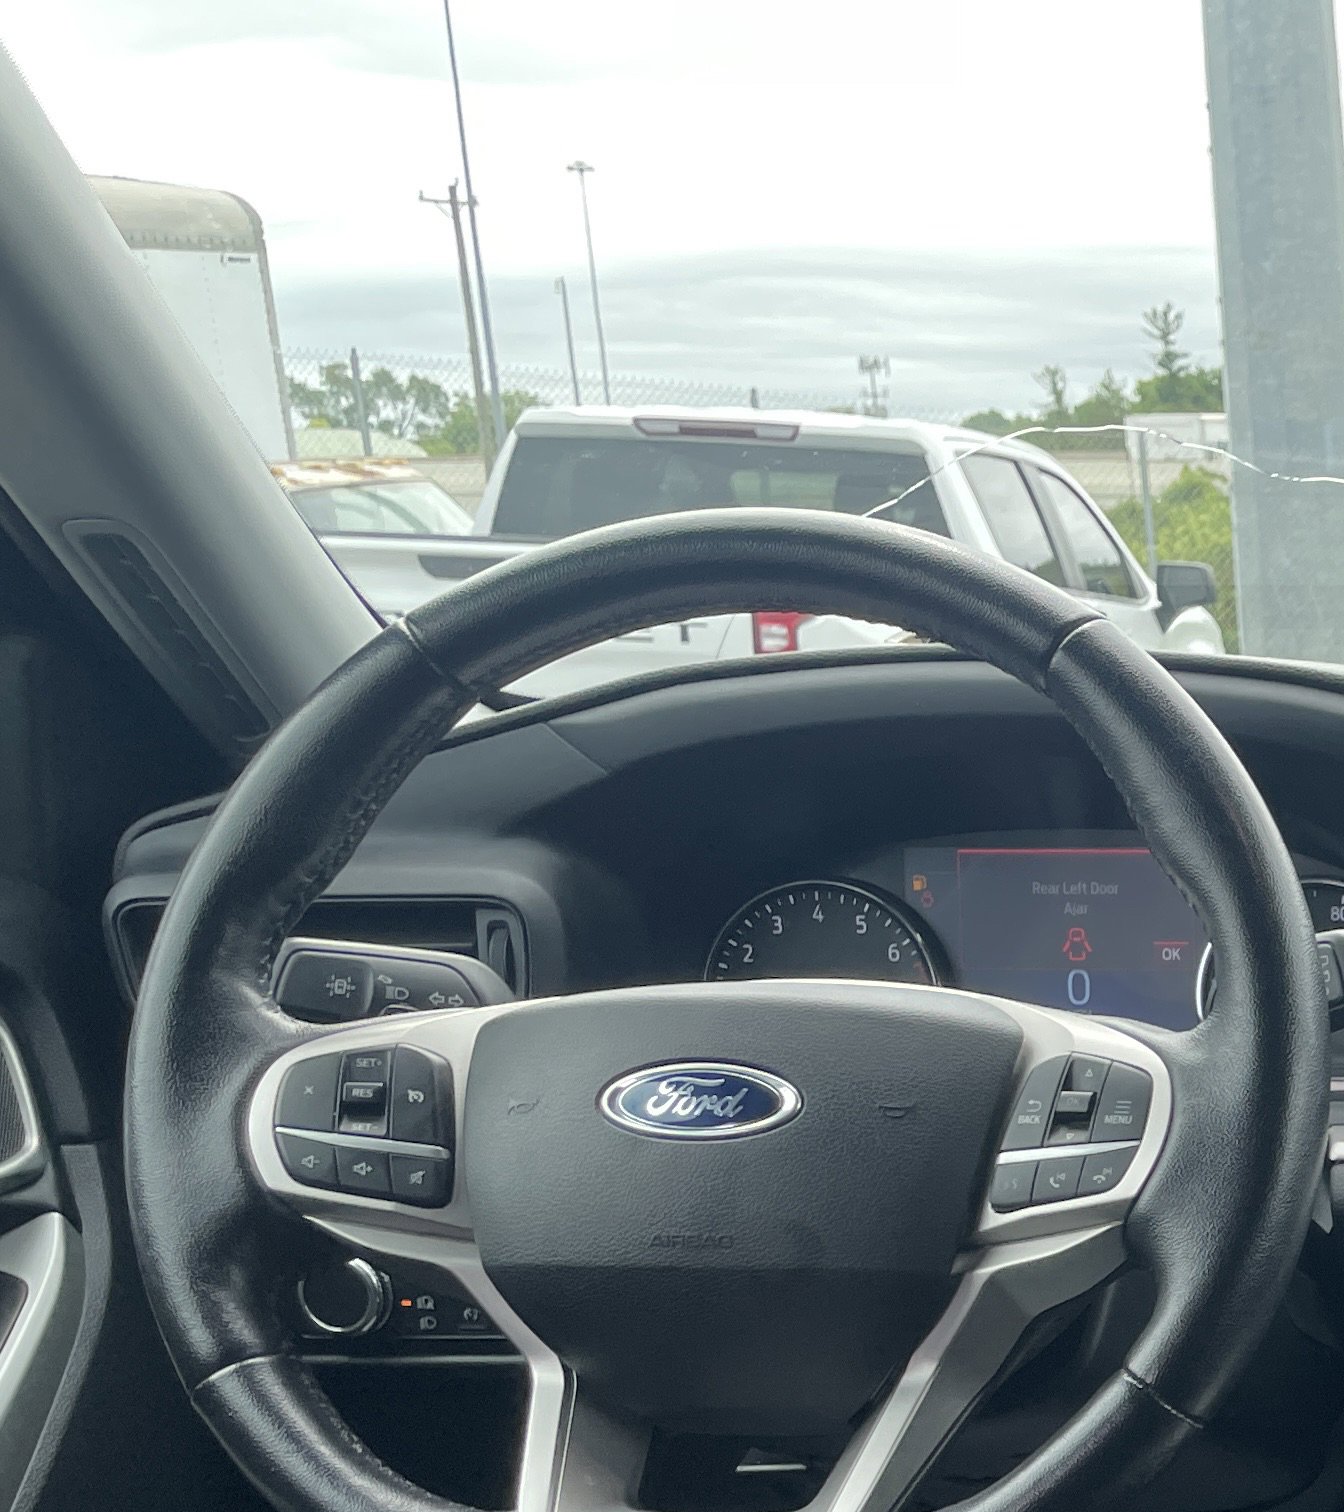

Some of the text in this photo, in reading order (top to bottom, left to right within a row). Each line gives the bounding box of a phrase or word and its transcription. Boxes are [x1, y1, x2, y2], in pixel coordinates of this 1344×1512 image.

[1032, 881, 1119, 895] Rear Left Door
[812, 904, 825, 923] 4
[1064, 902, 1088, 915] Ajar
[771, 916, 784, 935] 3
[855, 915, 867, 935] 5
[742, 944, 754, 963] 2
[887, 944, 900, 963] 6
[1162, 949, 1181, 961] OK
[1067, 969, 1091, 1005] 0
[352, 1089, 373, 1097] RES
[646, 1076, 749, 1119] Ford
[1018, 1115, 1041, 1125] BACK
[1104, 1115, 1133, 1124] MENU
